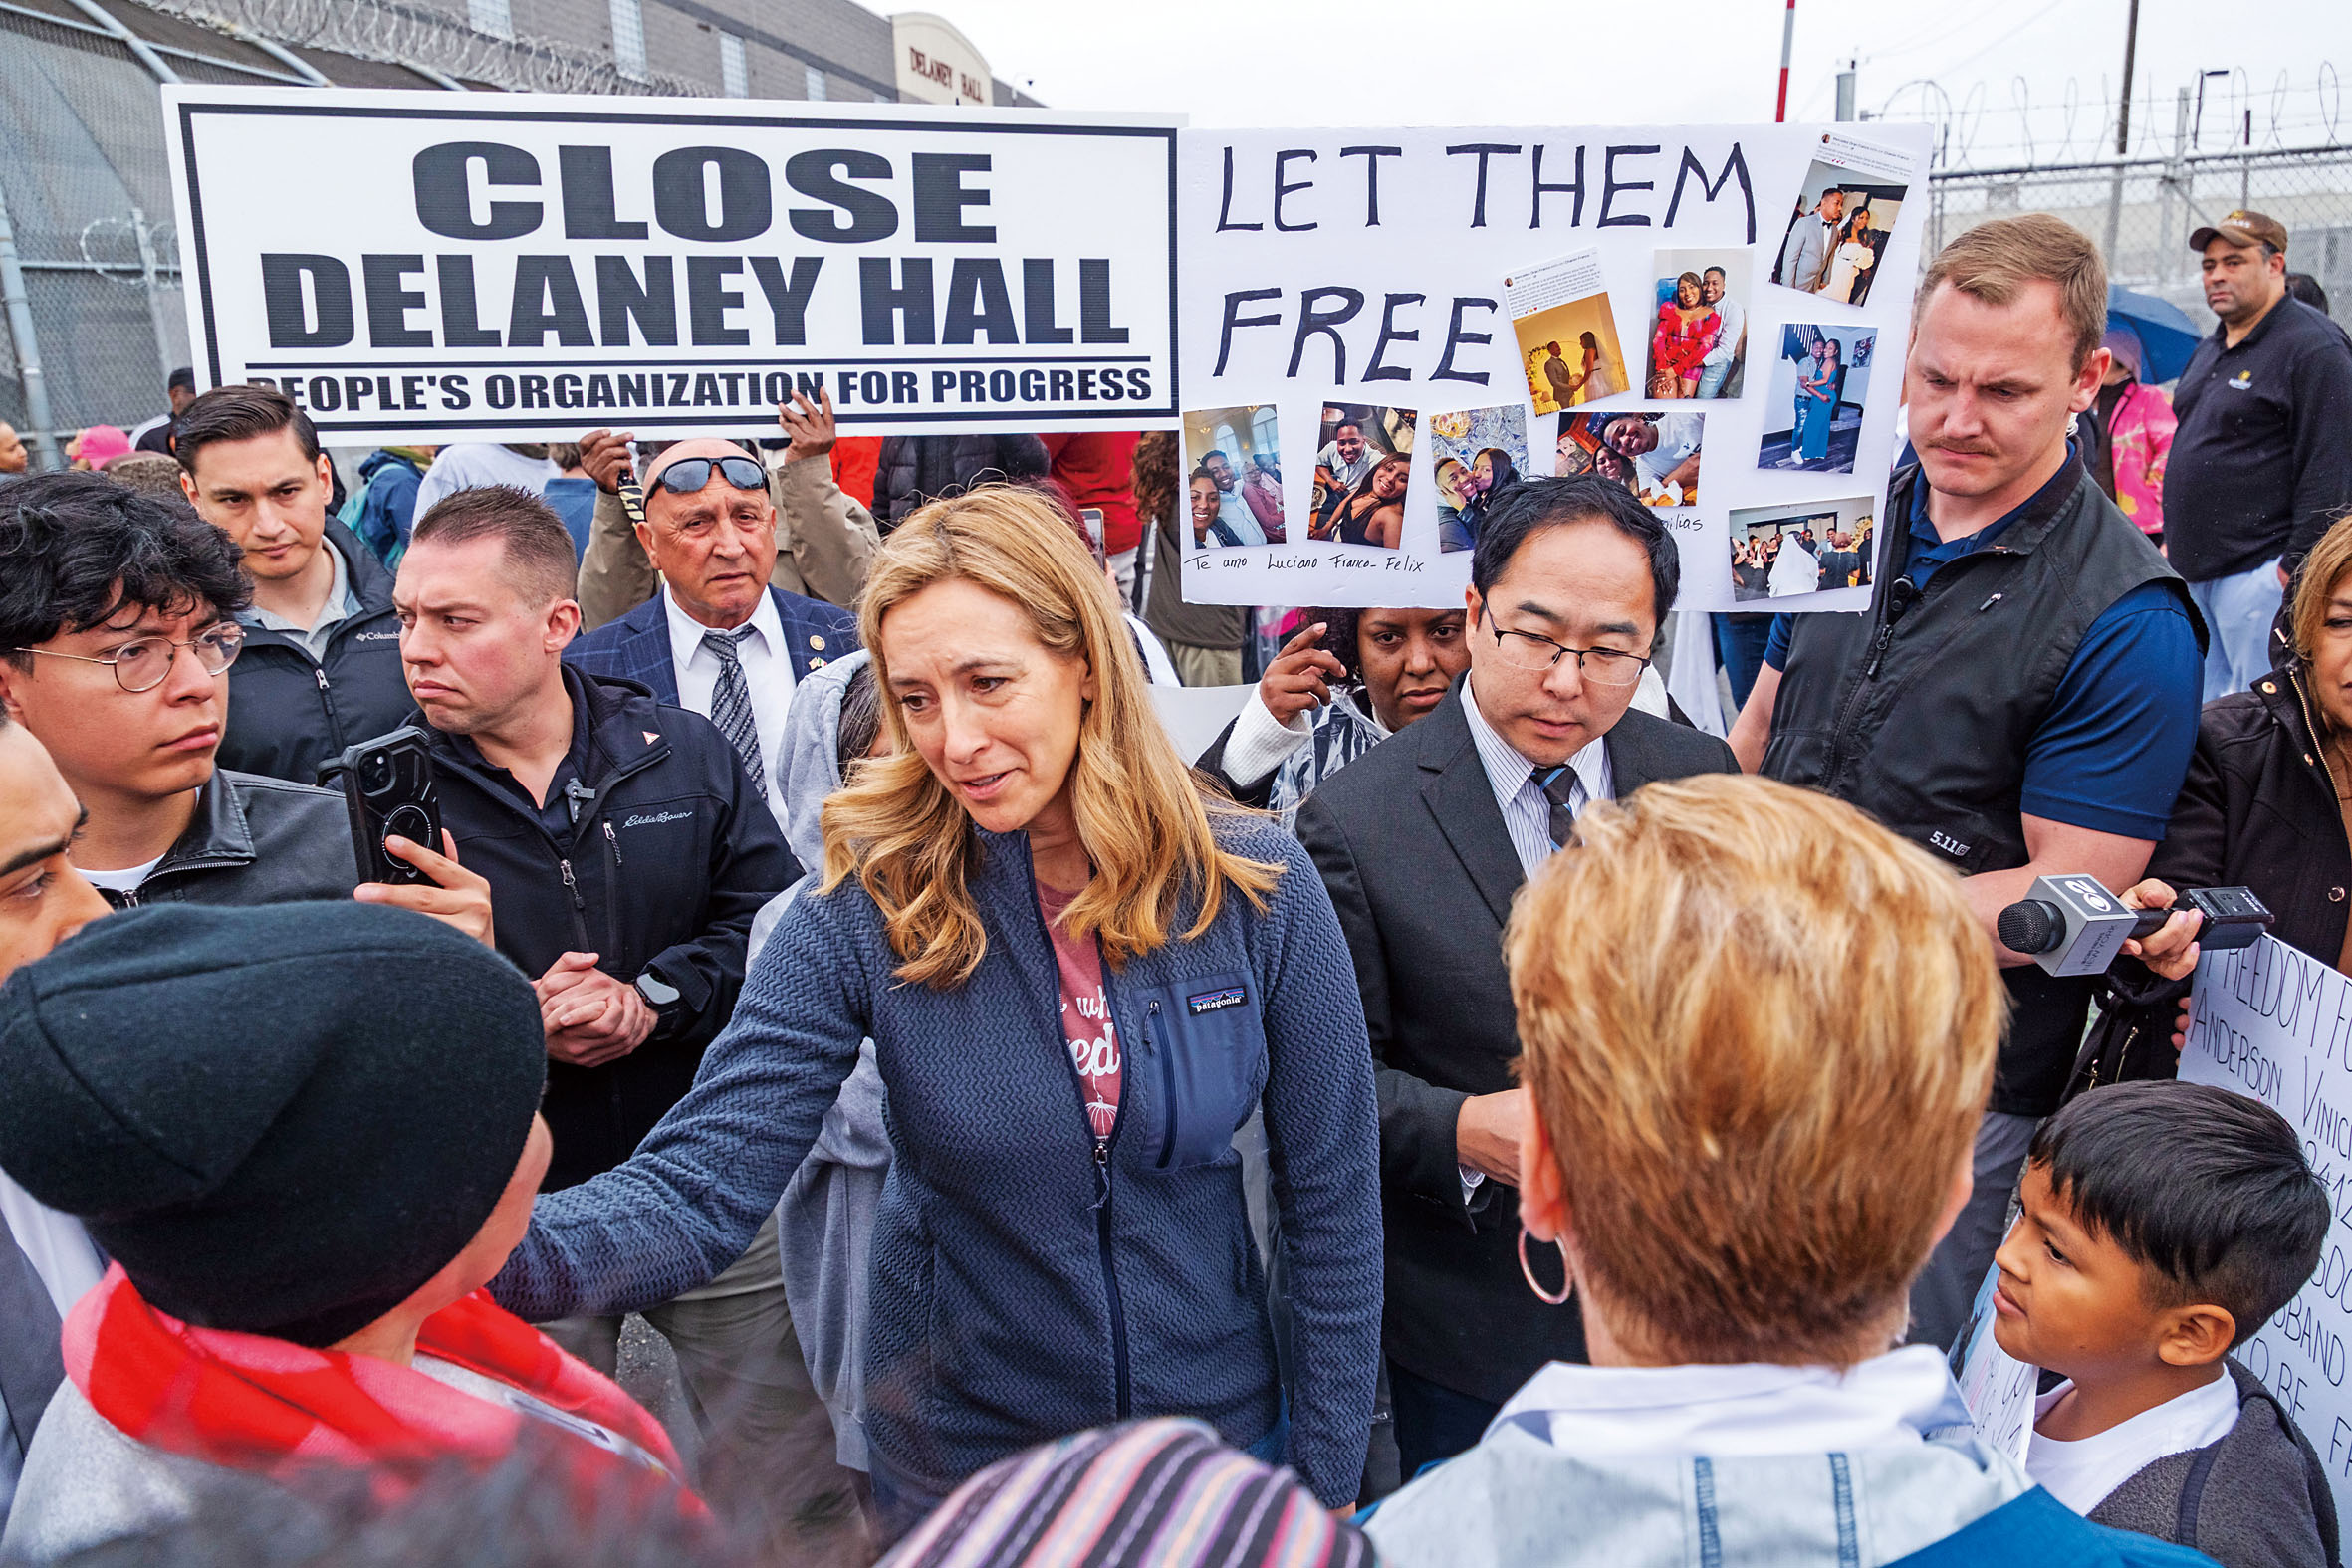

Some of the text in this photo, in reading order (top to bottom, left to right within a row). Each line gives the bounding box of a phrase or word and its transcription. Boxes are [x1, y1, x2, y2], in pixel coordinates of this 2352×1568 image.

[909, 46, 984, 104] DELANEY HALL
[412, 141, 997, 243] CLOSE
[1215, 146, 1402, 233] LET
[1446, 142, 1756, 244] THEM
[261, 253, 1129, 348] DELANEY HALL
[1213, 286, 1498, 386] FREE
[485, 371, 823, 410] ORGANIZATION
[837, 370, 918, 404] FOR
[932, 368, 1152, 403] PROGRESS
[1184, 554, 1211, 570] Te
[1223, 558, 1248, 568] amo
[1268, 553, 1318, 569] Luciano
[366, 631, 400, 640] Columb
[1076, 985, 1112, 1019] wh
[1196, 995, 1243, 1012] patagonia
[1066, 1022, 1121, 1076] ed
[2190, 987, 2282, 1105] ANDERSON
